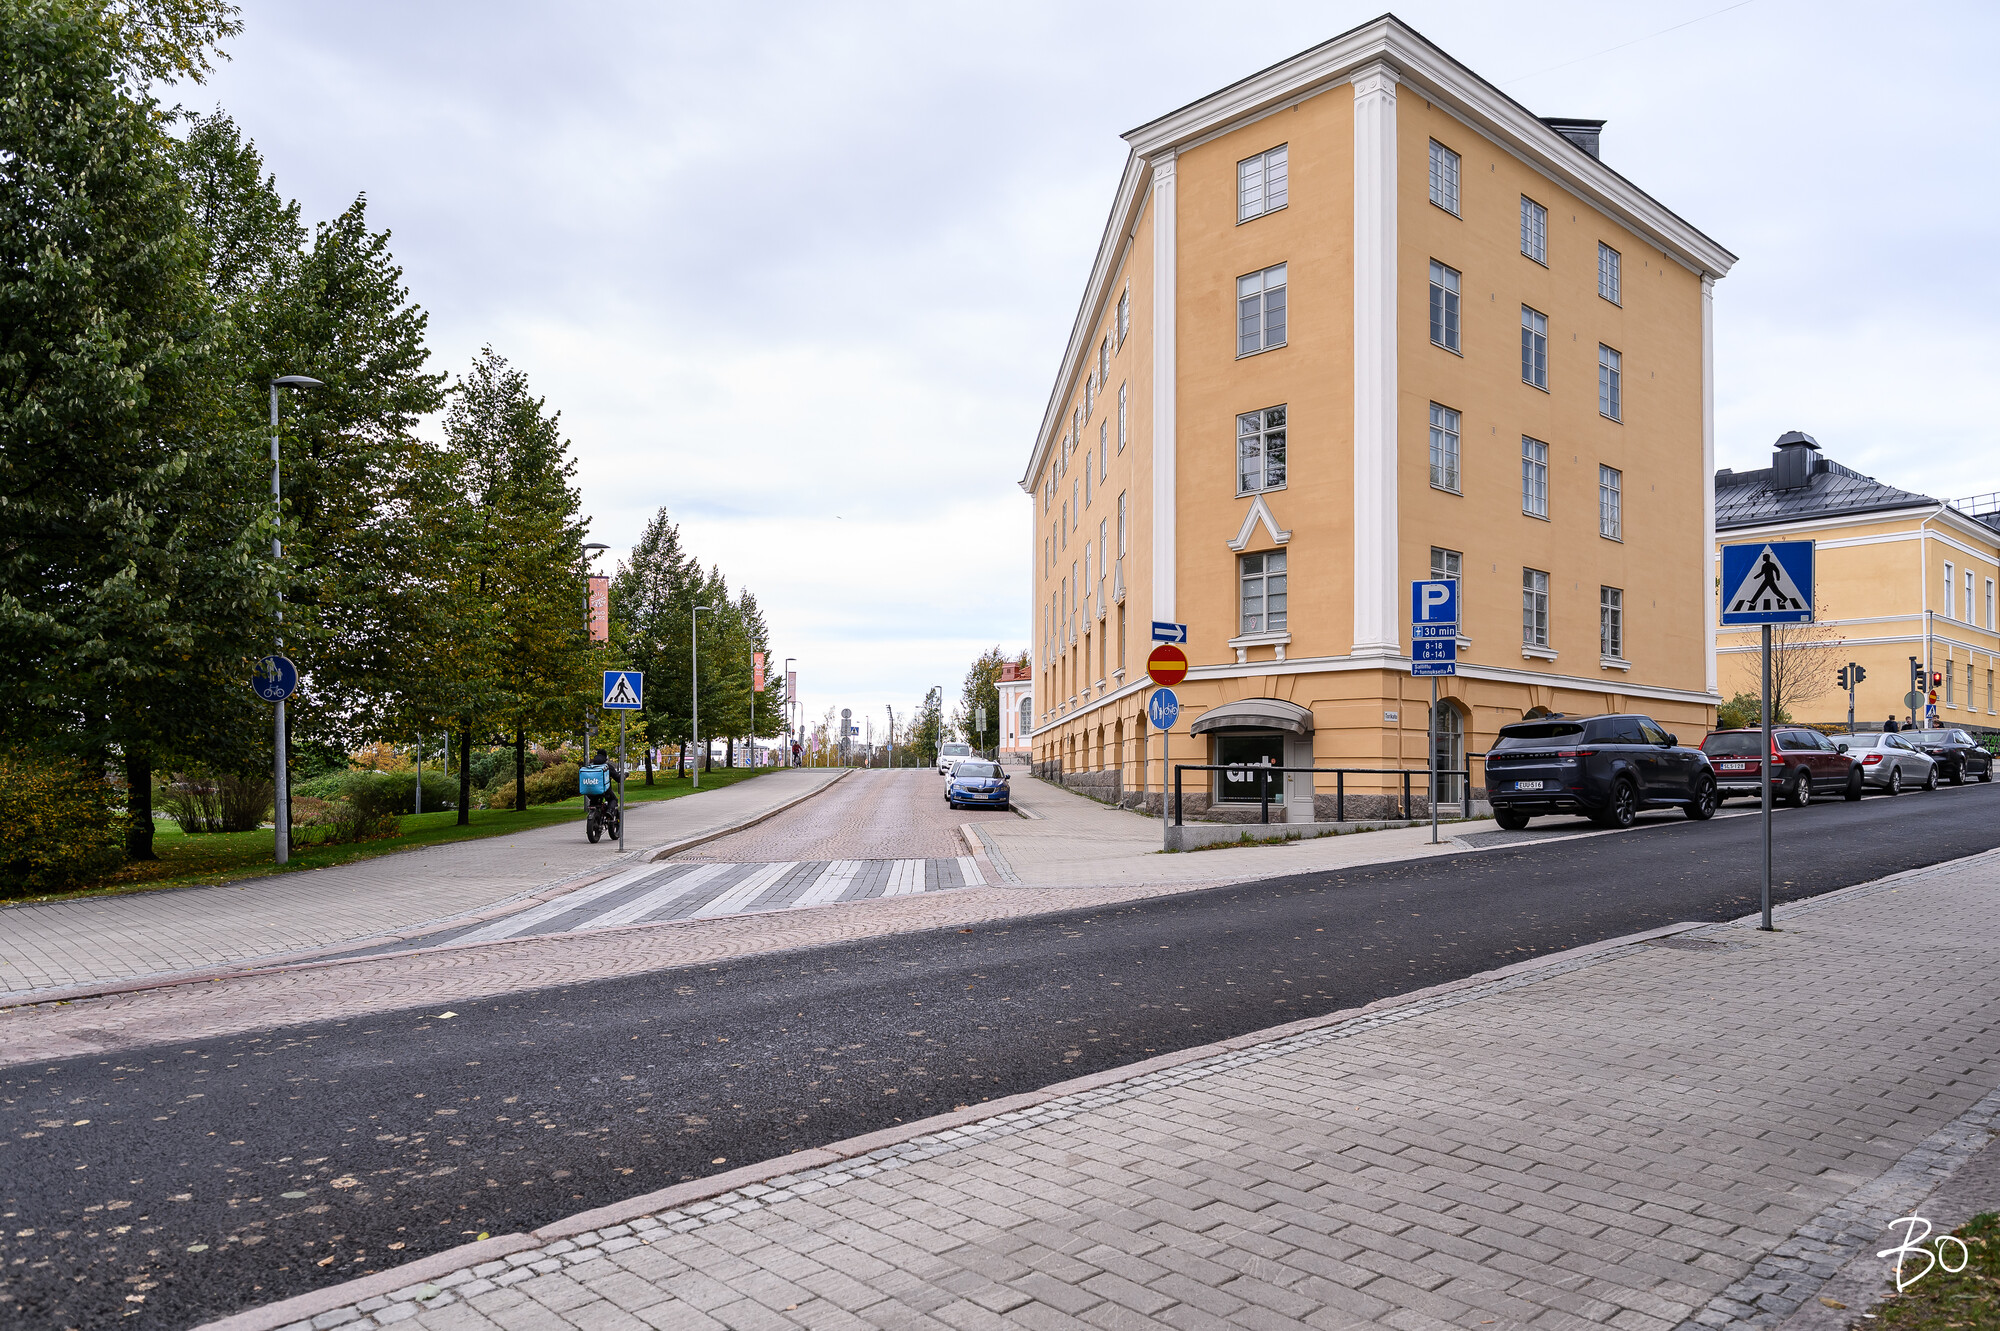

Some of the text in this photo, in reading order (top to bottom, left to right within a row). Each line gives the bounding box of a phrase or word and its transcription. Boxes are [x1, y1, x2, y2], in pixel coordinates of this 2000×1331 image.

[1421, 583, 1450, 620] P
[1424, 626, 1455, 636] 30 min
[1425, 642, 1443, 650] 8-18
[1422, 650, 1446, 659] (8-14)
[1446, 664, 1453, 674] A
[582, 777, 599, 785] Wolt
